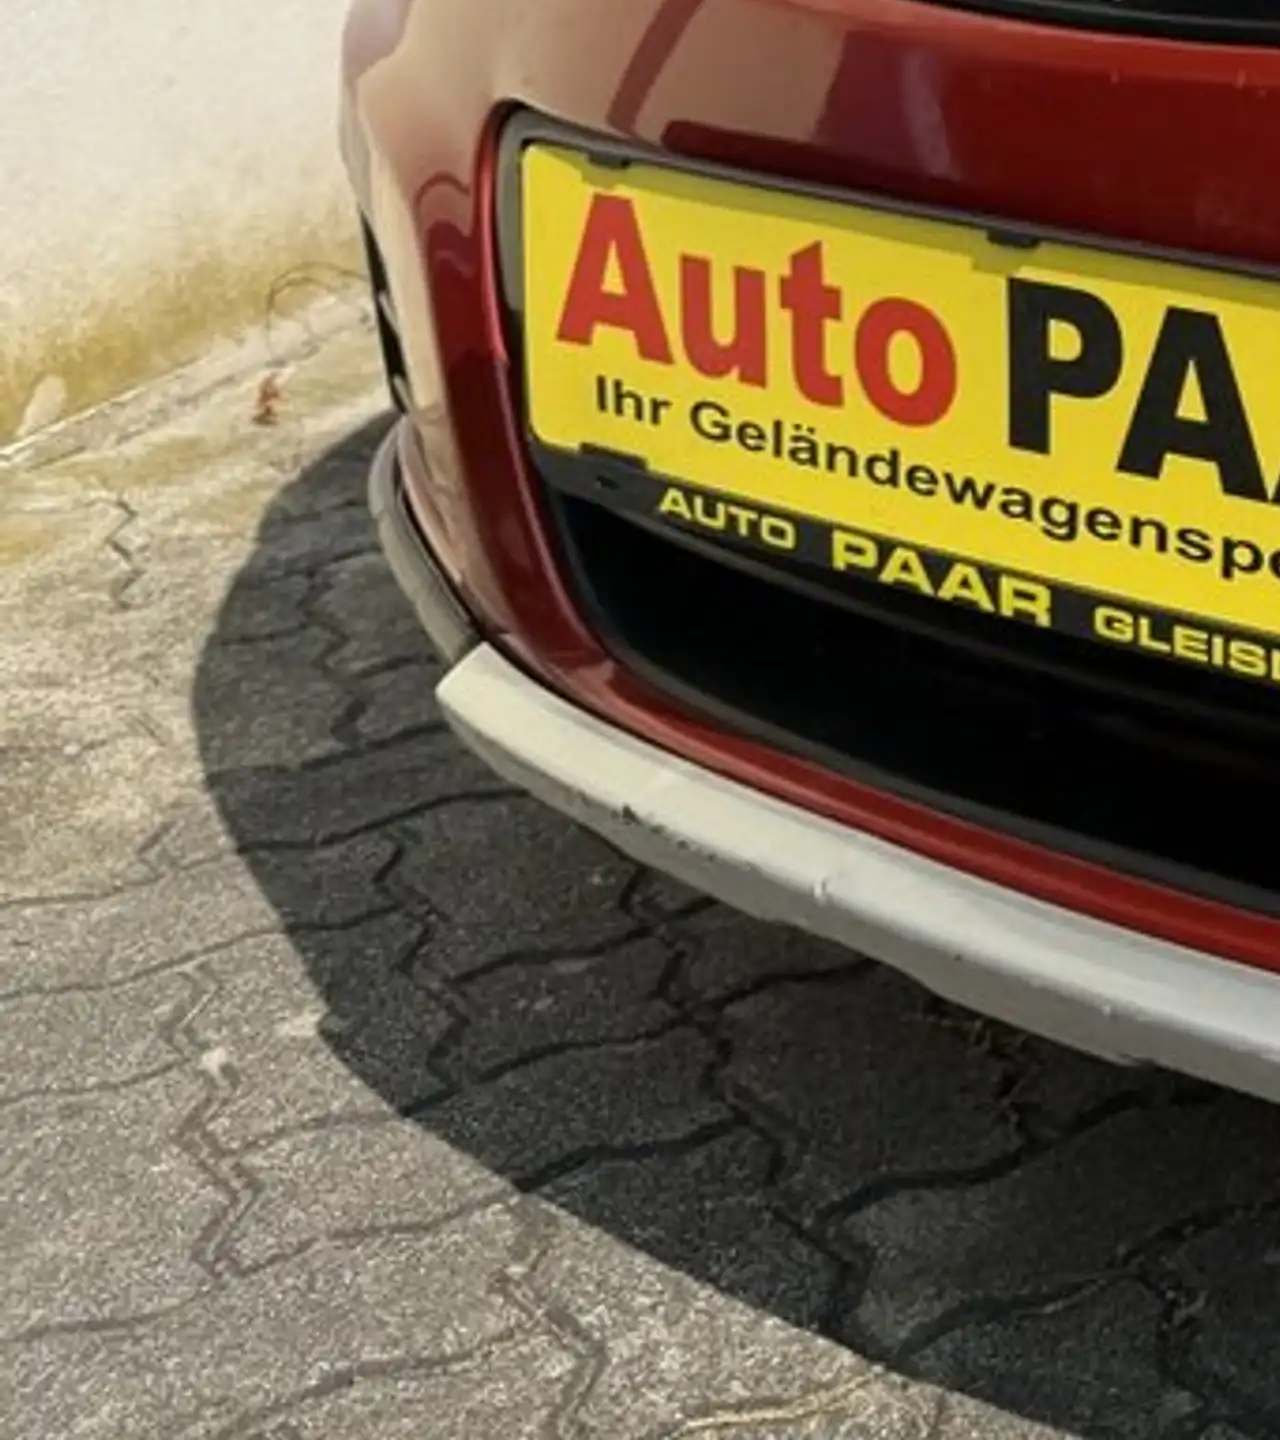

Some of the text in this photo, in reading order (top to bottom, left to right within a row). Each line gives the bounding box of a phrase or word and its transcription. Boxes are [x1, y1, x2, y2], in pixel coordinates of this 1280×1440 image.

[557, 194, 954, 426] Auto
[596, 375, 670, 426] Ihr
[658, 486, 797, 550] AUTO
[831, 529, 1052, 628] PAAR
